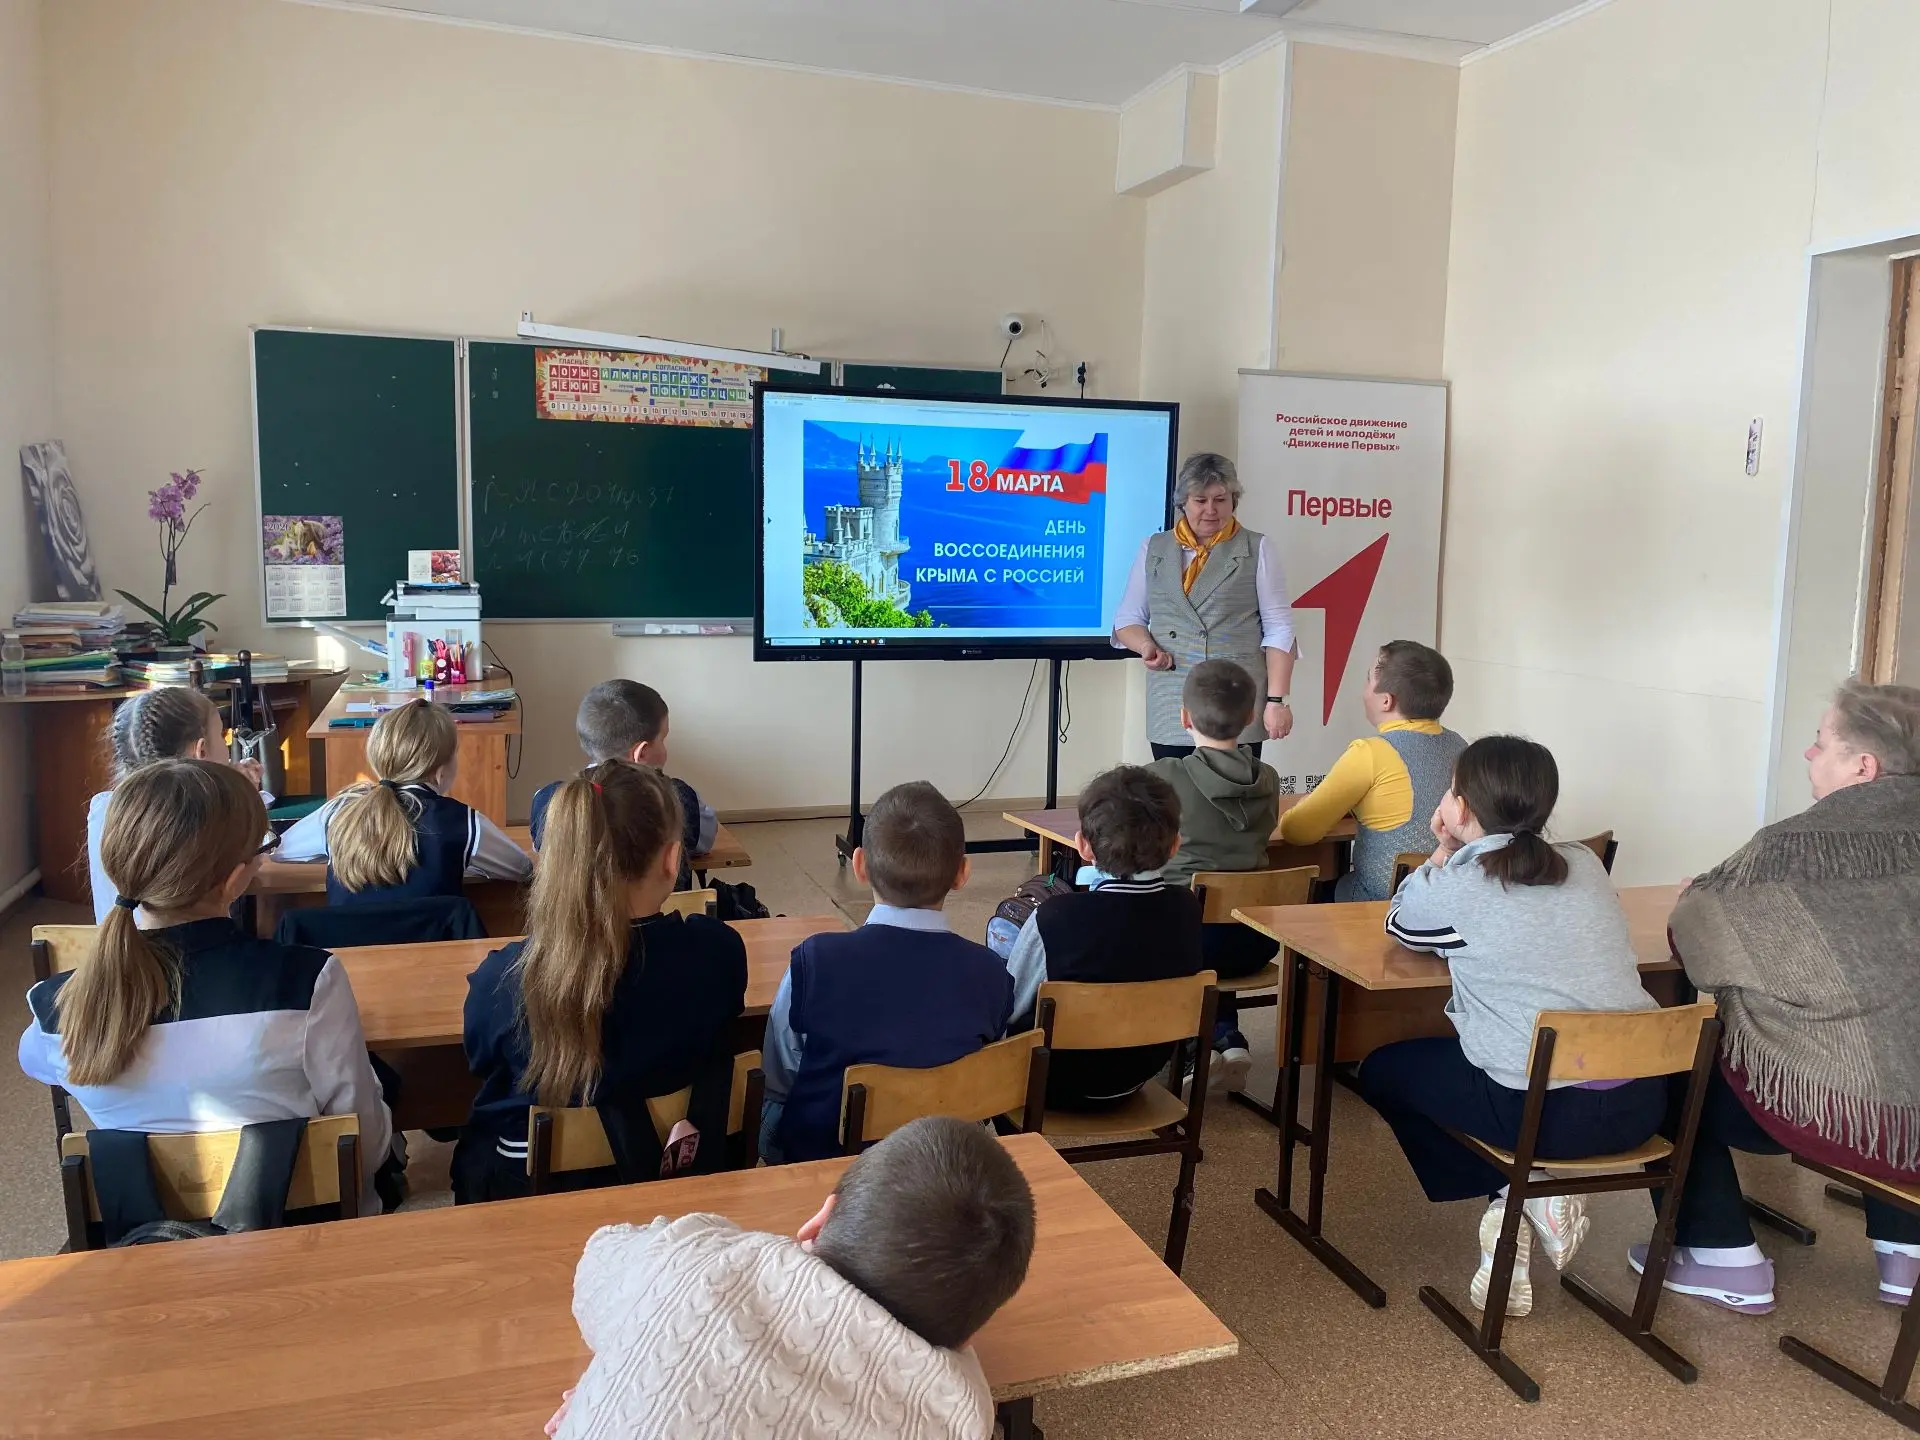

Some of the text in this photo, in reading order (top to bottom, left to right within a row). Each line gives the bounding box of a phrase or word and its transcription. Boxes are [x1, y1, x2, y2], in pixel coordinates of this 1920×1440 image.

[1276, 413, 1408, 429] Российское движение
[1289, 426, 1396, 440] детей и молодёжи
[1282, 437, 1400, 452] «Движение Первых»
[945, 459, 1064, 493] 18 МАРТА
[1287, 489, 1392, 525] Первые
[1044, 519, 1086, 536] ДЕНЬ
[934, 542, 1085, 561] ВОССОЕДИНЕНИЯ
[916, 566, 1085, 584] КРЫМА С РОССИЕЙ
